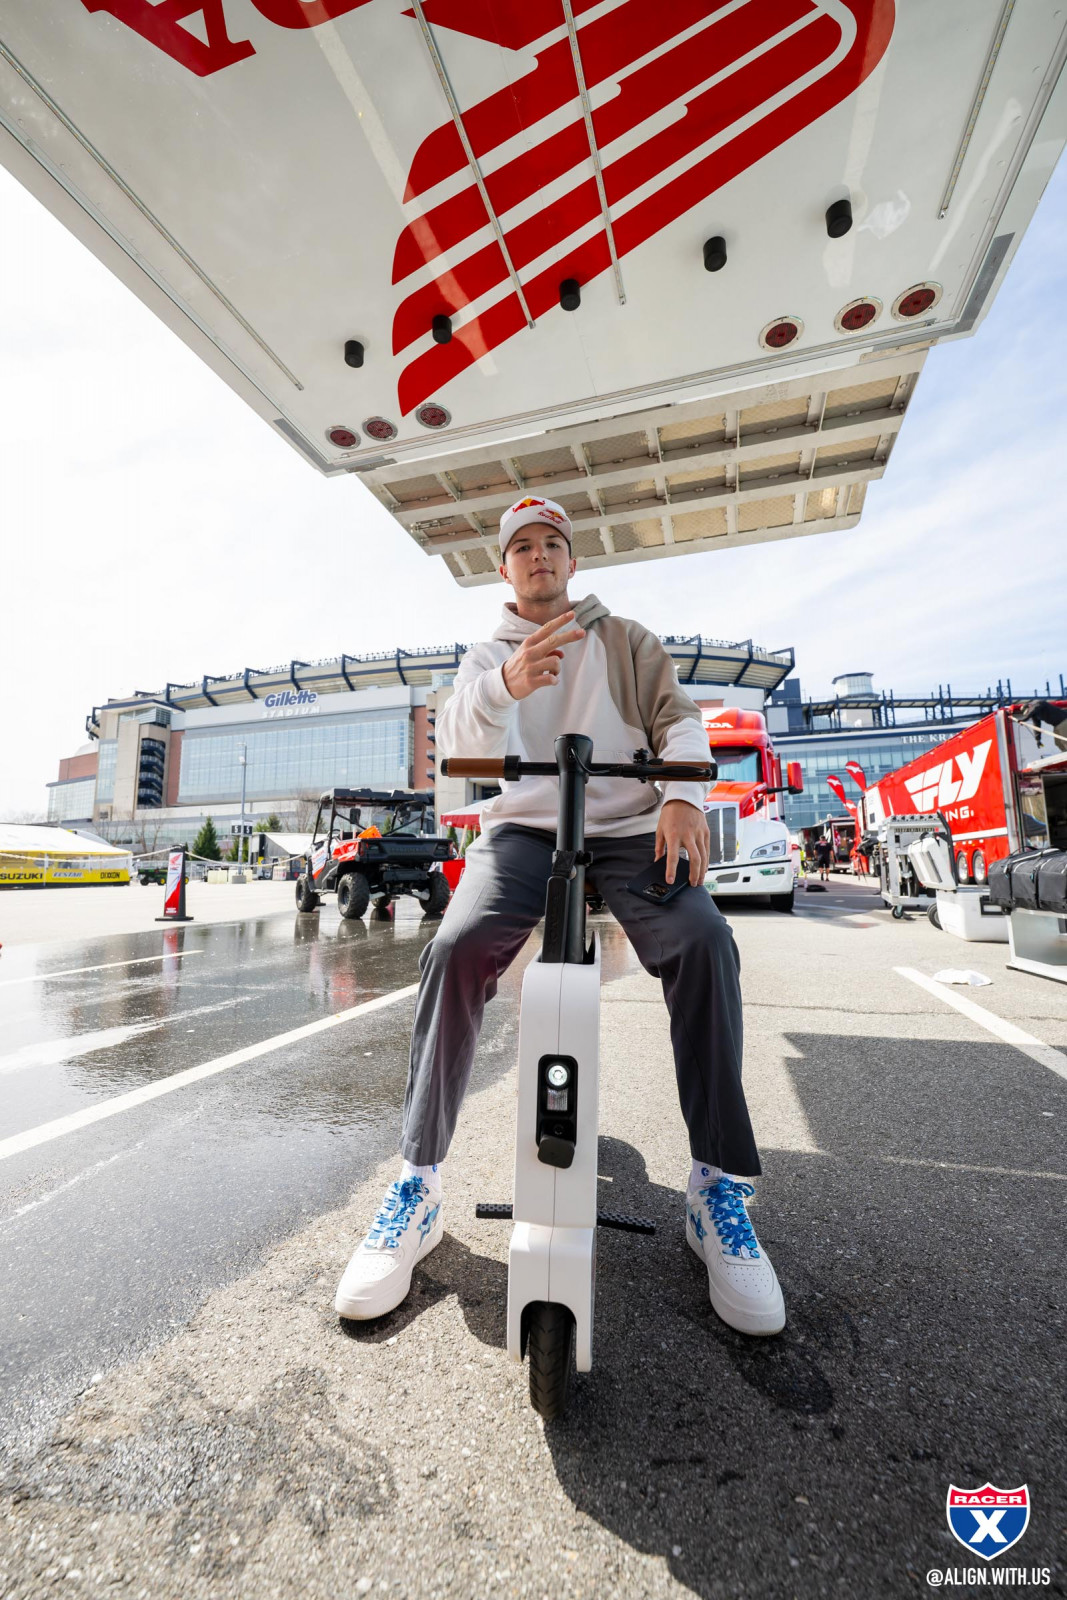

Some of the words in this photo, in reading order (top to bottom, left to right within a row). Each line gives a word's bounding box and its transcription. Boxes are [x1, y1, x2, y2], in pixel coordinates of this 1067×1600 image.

[264, 690, 317, 708] Gillette
[262, 706, 320, 719] STADIUM
[901, 735, 925, 744] THE
[929, 733, 957, 742] KRA
[904, 739, 993, 813] FLY
